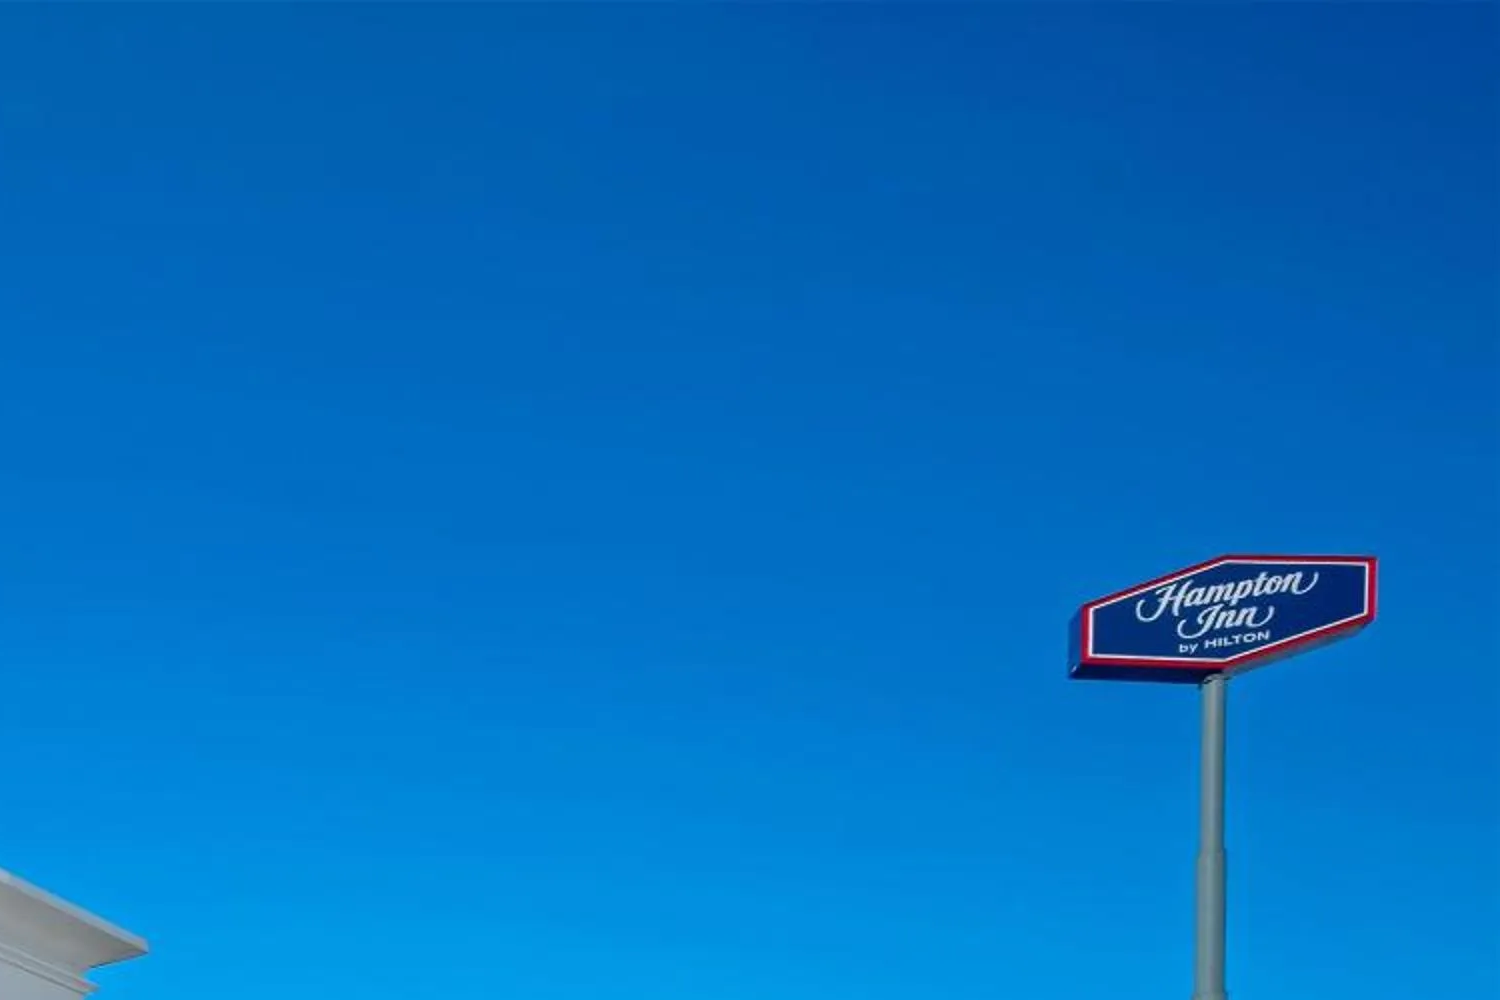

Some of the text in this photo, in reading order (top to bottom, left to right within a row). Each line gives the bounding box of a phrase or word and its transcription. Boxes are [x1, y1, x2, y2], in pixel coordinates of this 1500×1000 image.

[1135, 571, 1319, 622] Hampton
[1177, 603, 1275, 639] Inn
[1204, 630, 1271, 650] HILTON
